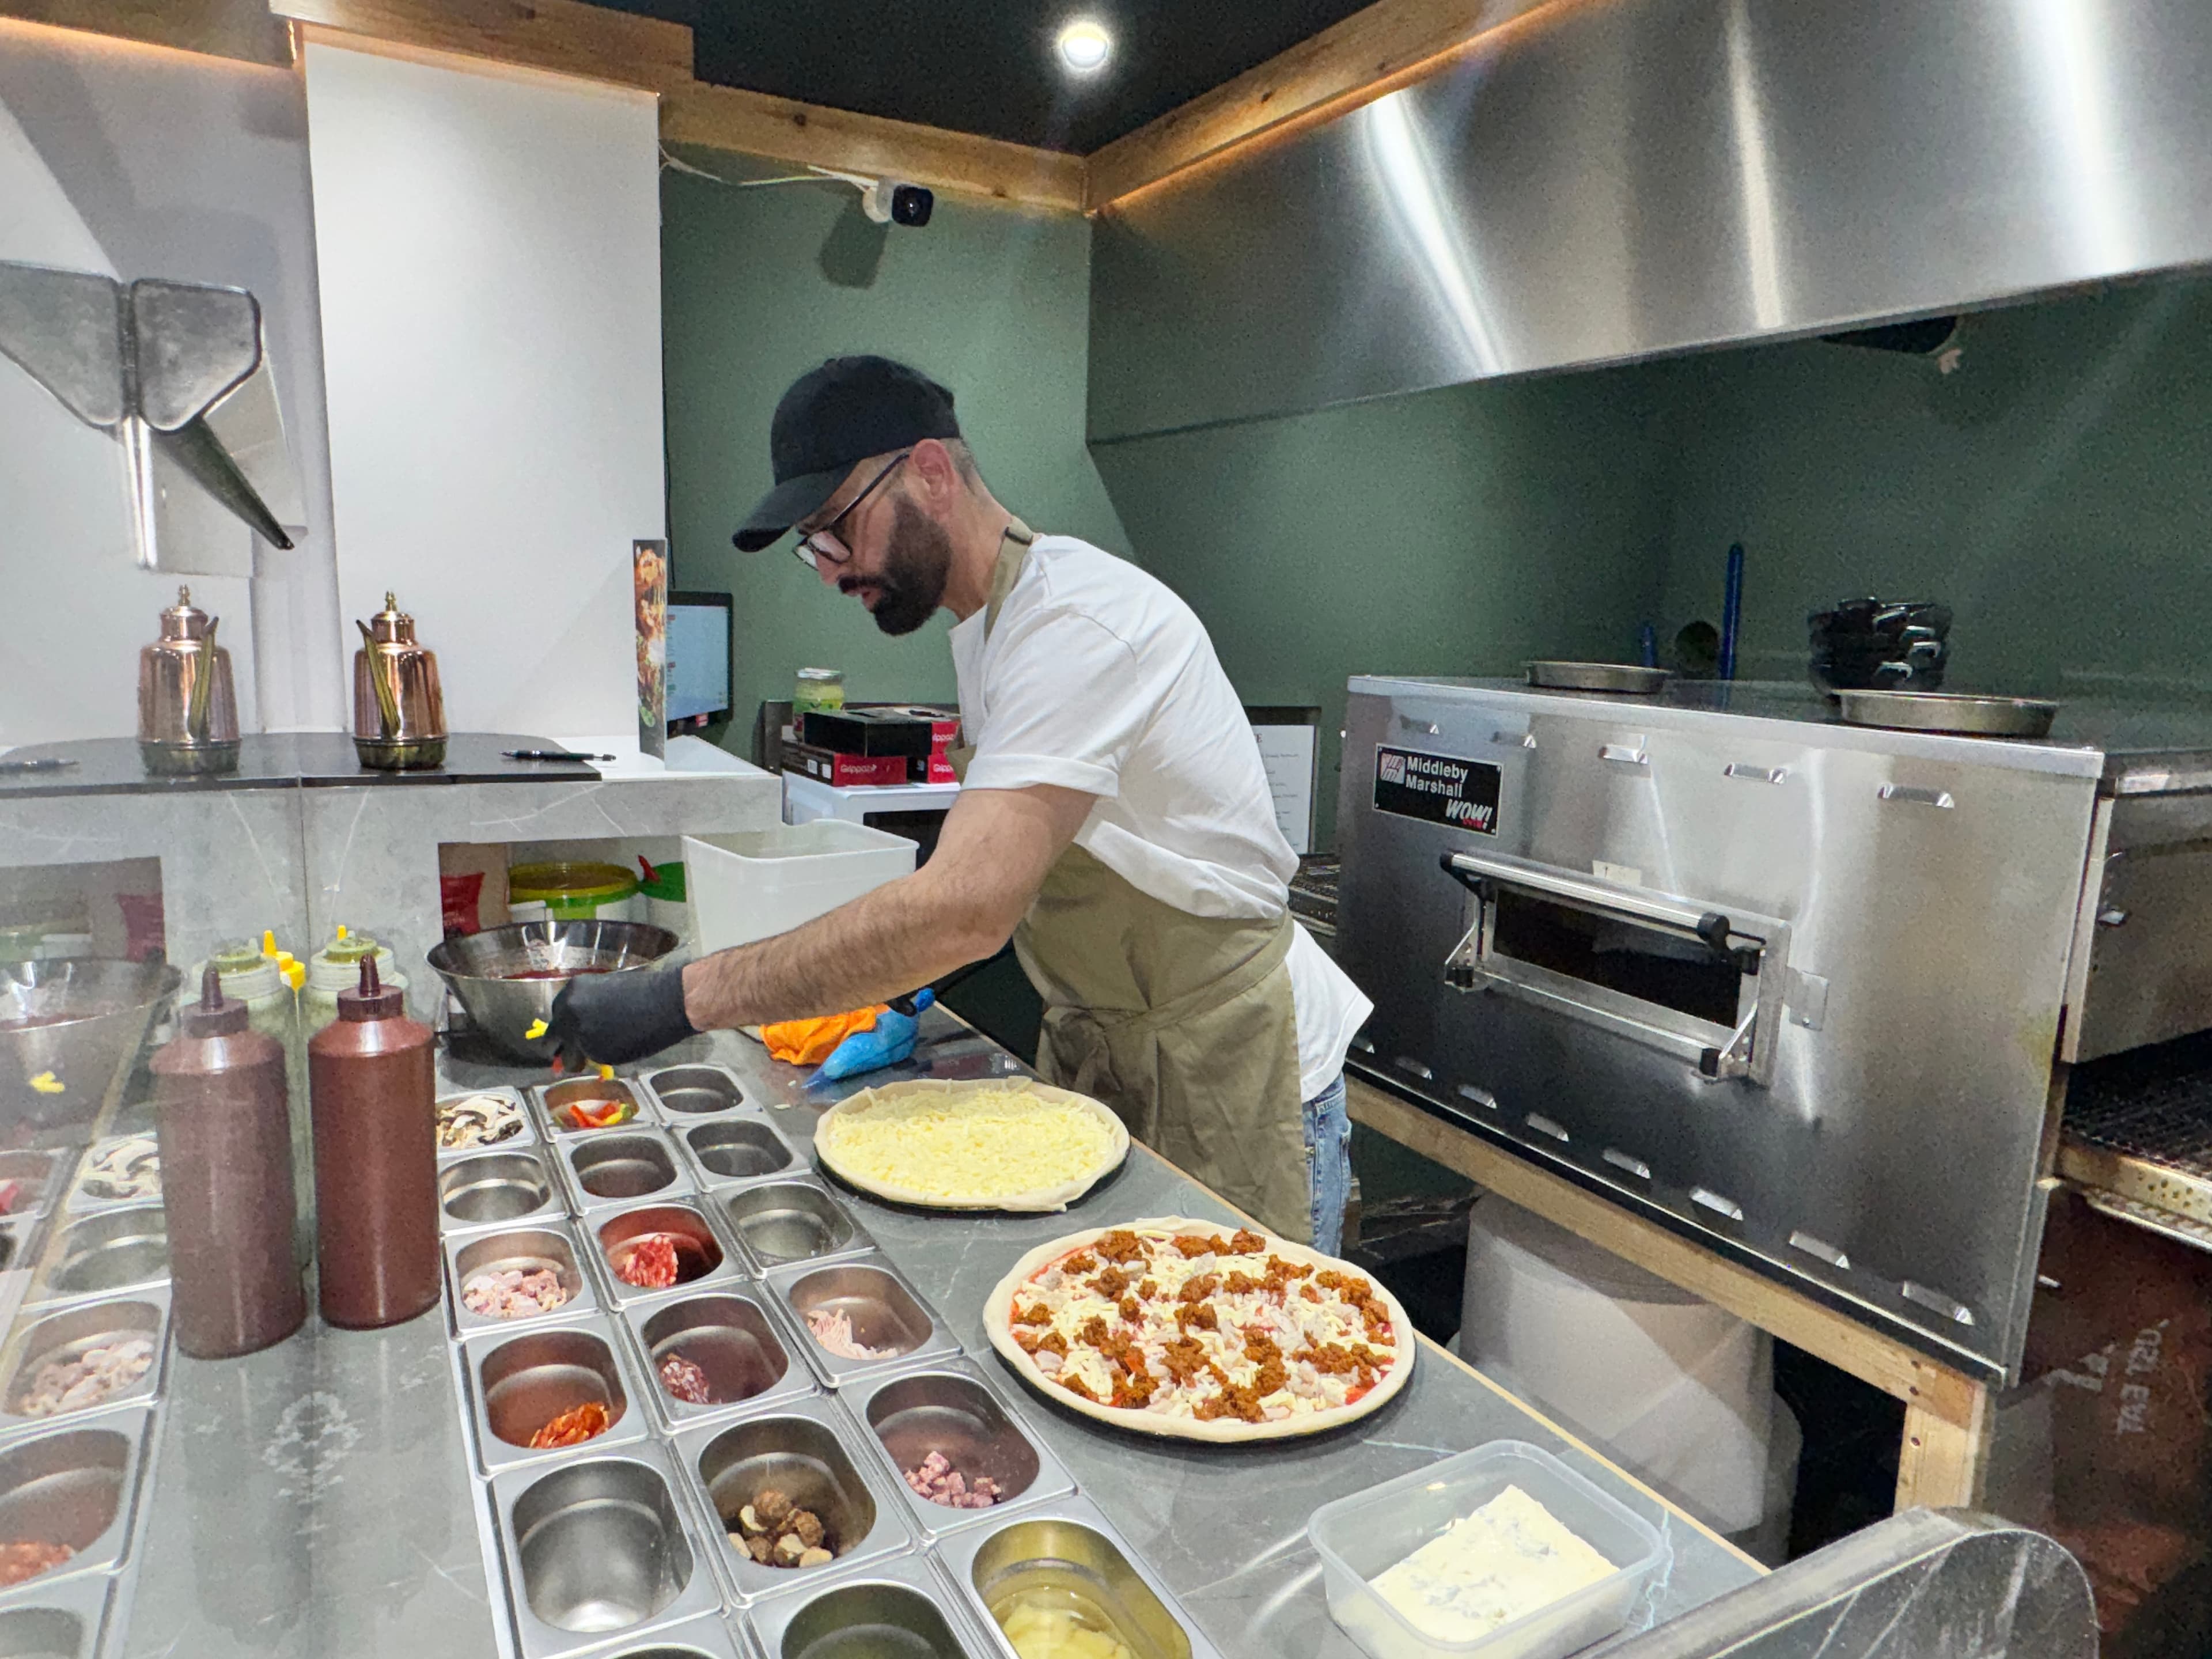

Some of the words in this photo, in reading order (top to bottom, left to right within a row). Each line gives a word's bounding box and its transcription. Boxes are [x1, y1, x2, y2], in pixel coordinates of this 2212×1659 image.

[1407, 756, 1468, 783] Middleby
[1406, 774, 1463, 798] Marshall
[1445, 798, 1493, 830] WOW!
